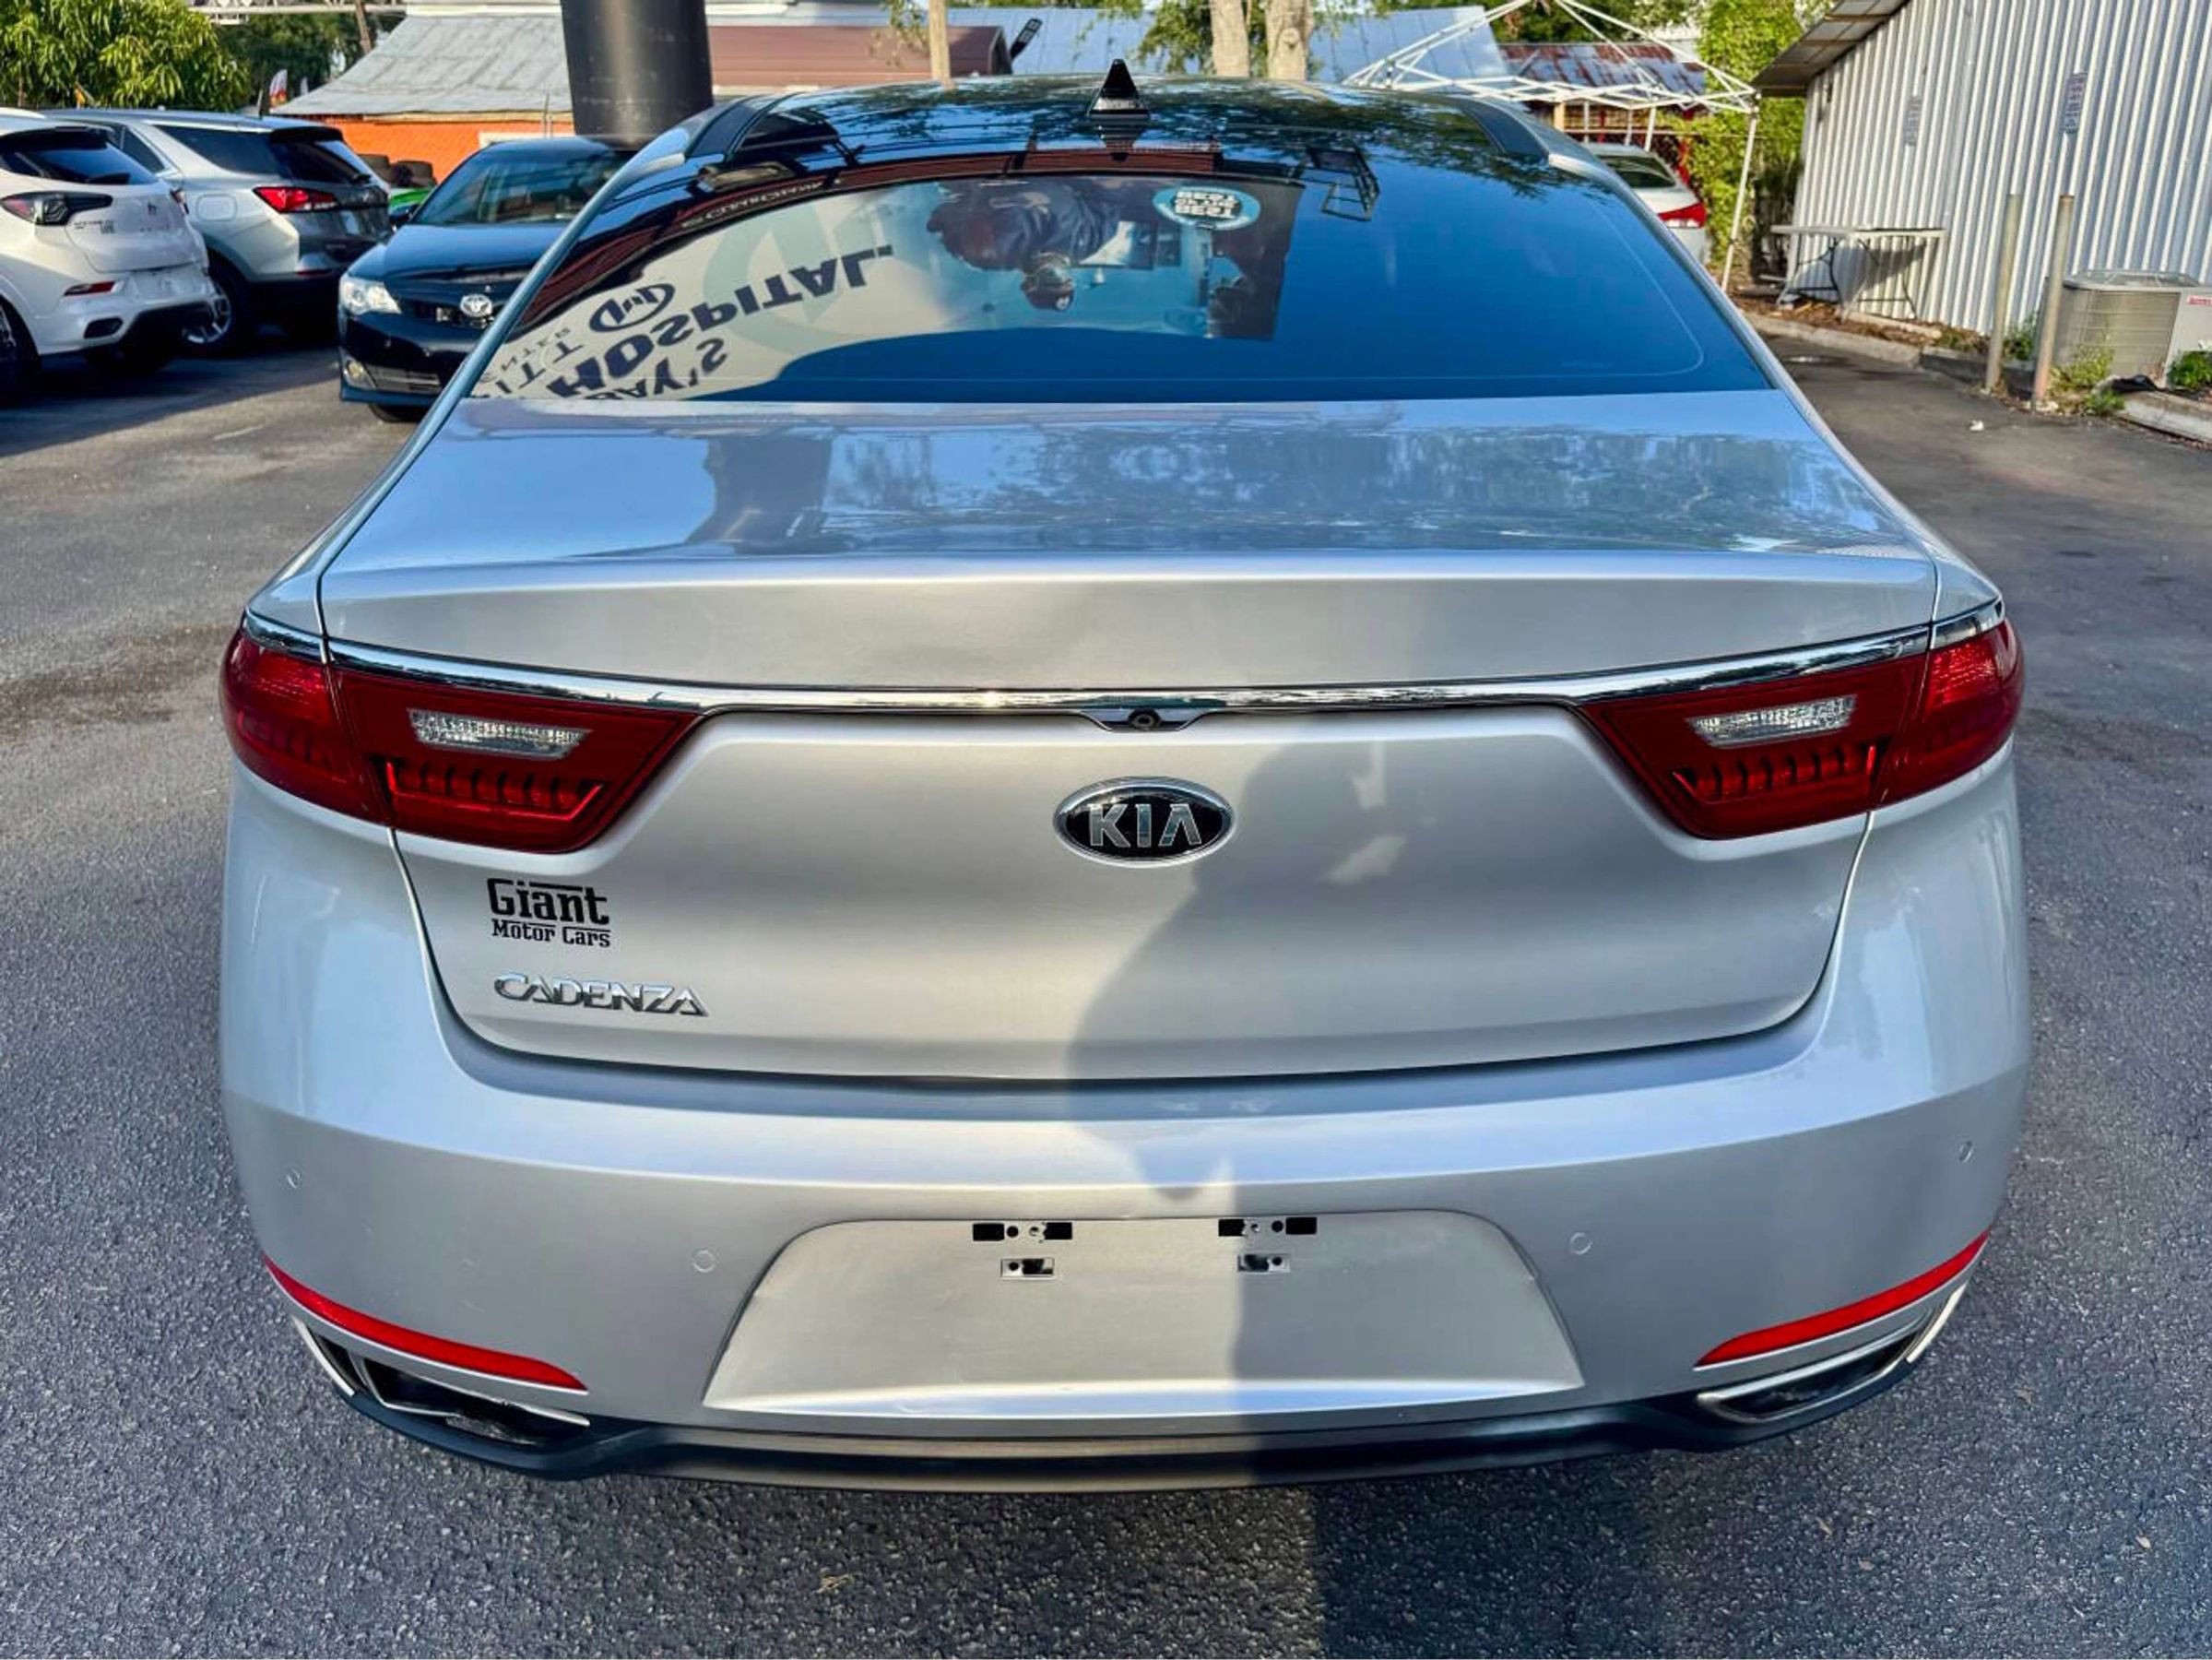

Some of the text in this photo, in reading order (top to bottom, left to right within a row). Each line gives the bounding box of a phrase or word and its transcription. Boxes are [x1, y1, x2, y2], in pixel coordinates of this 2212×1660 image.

[1088, 803, 1202, 848] KIA
[487, 878, 610, 925] Giant
[491, 919, 611, 947] Motor Cars
[494, 971, 708, 1017] CADENZA
